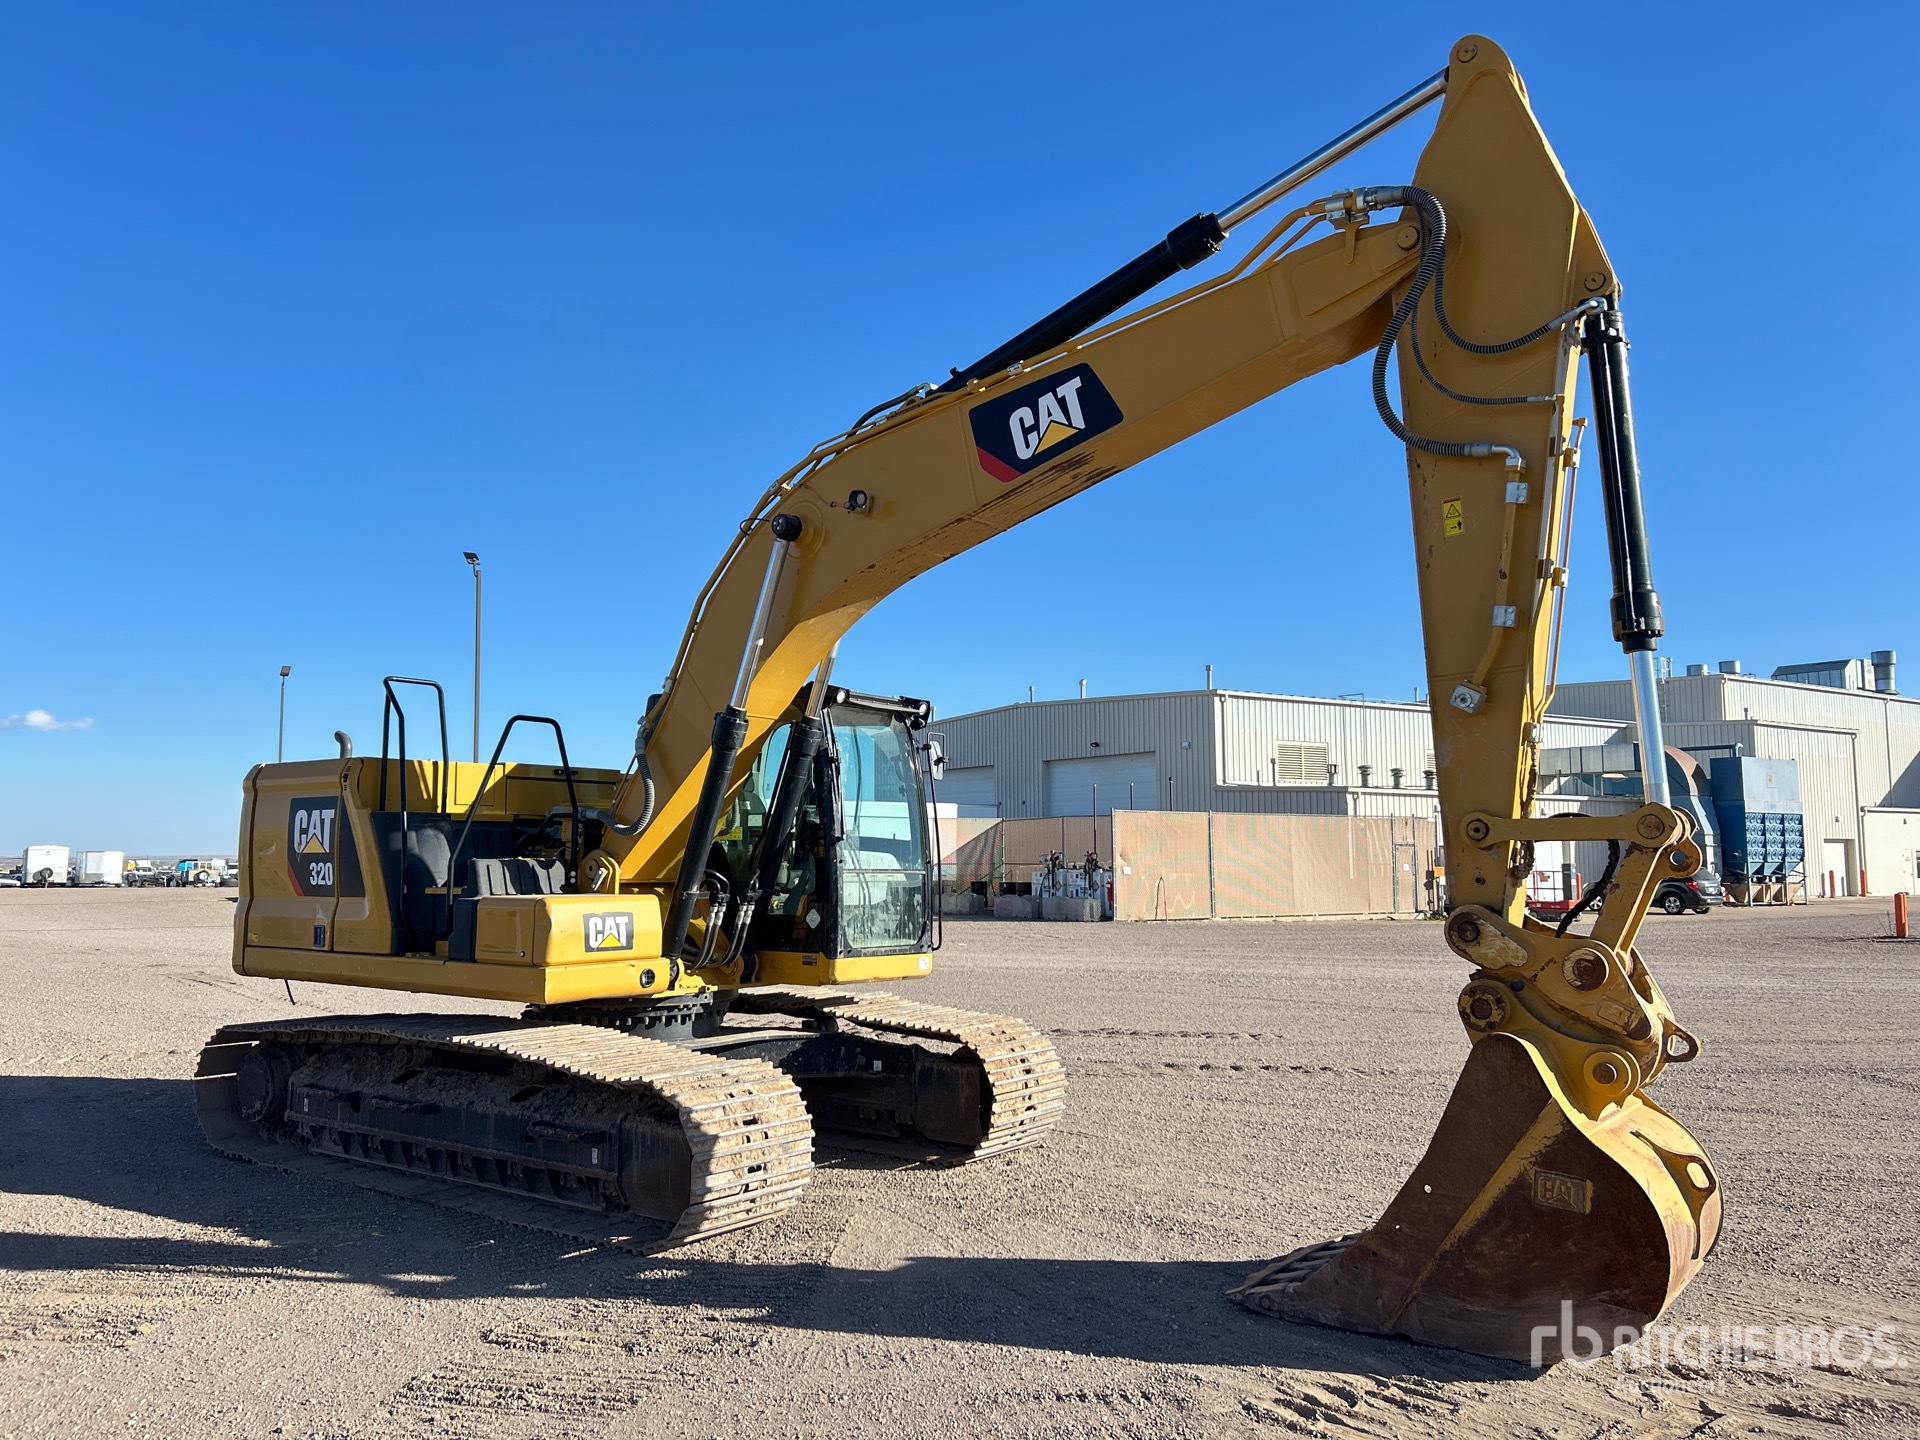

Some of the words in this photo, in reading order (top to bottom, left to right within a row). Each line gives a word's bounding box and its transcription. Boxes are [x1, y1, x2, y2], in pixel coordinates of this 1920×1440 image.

[1009, 376, 1085, 460] CAT
[293, 809, 335, 853] CAT
[309, 862, 333, 886] 320
[588, 916, 629, 949] CAT
[1538, 1177, 1579, 1209] CAT
